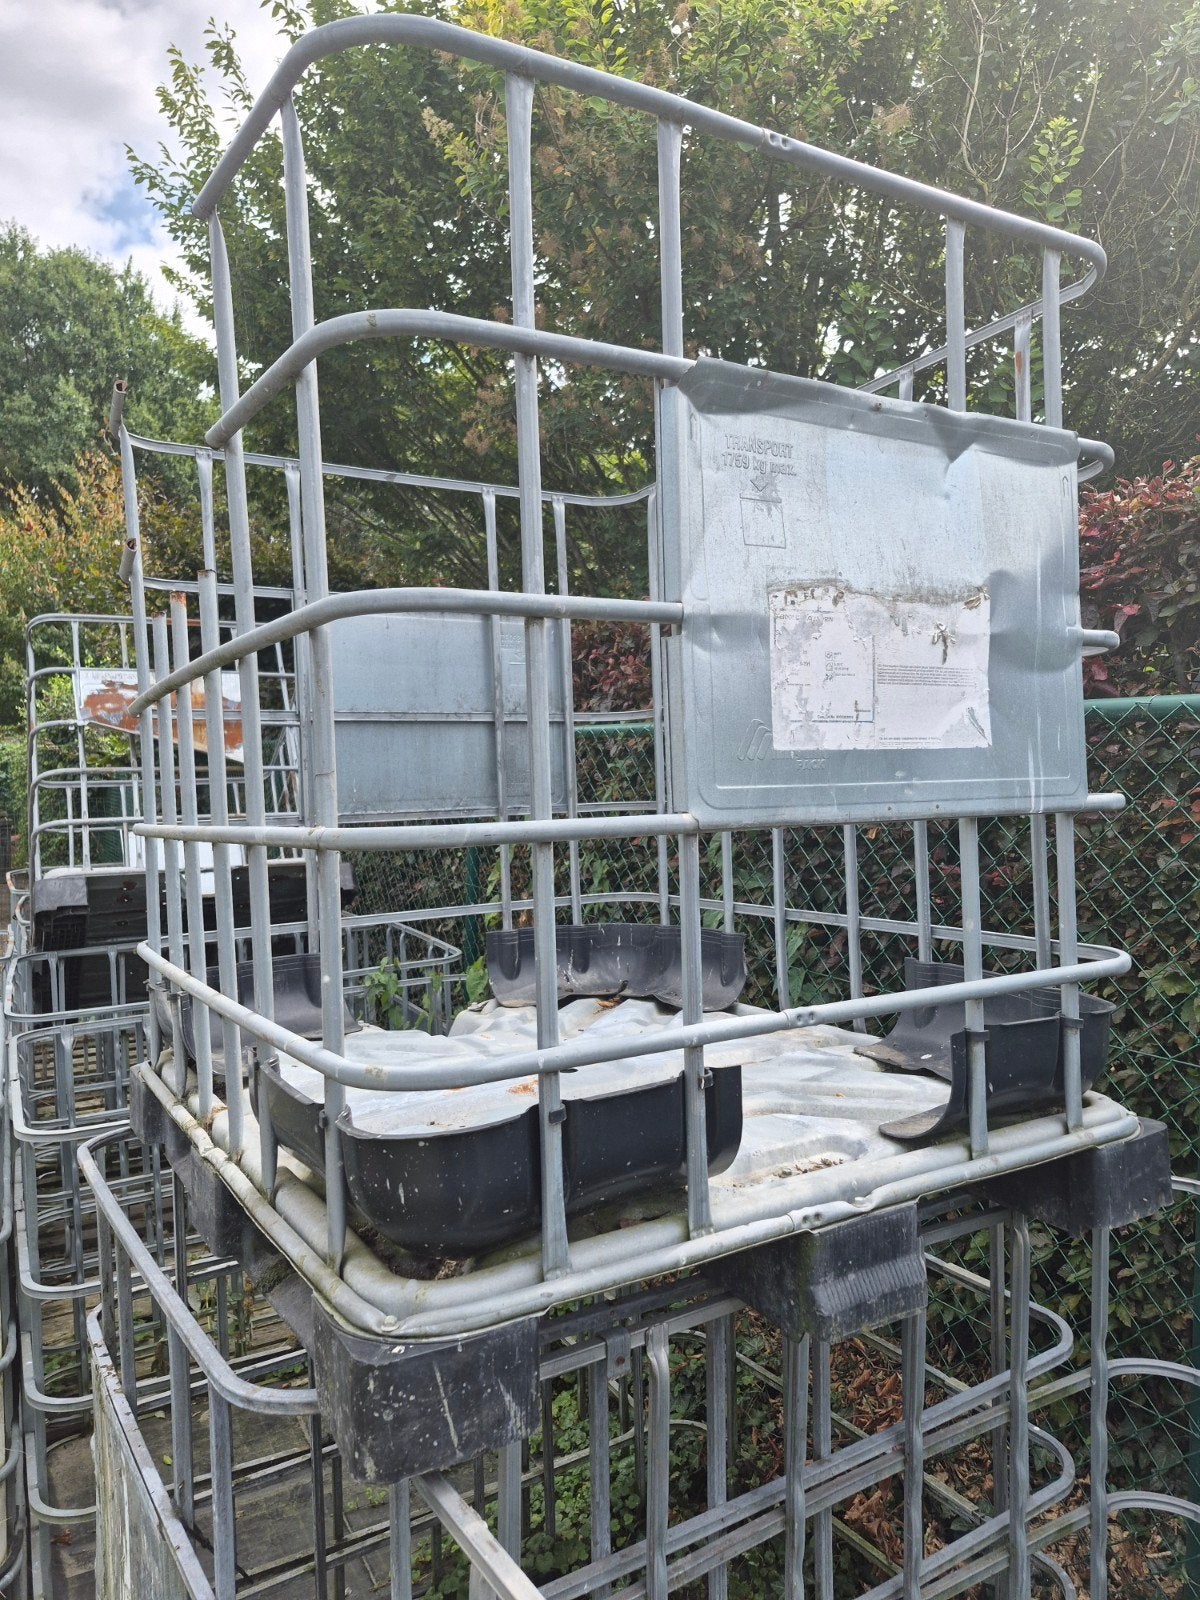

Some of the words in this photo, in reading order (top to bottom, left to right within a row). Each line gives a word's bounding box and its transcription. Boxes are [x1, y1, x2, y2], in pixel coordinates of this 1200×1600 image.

[724, 433, 794, 459] TRANSPORT
[721, 451, 750, 469] 1759
[752, 455, 767, 475] kg
